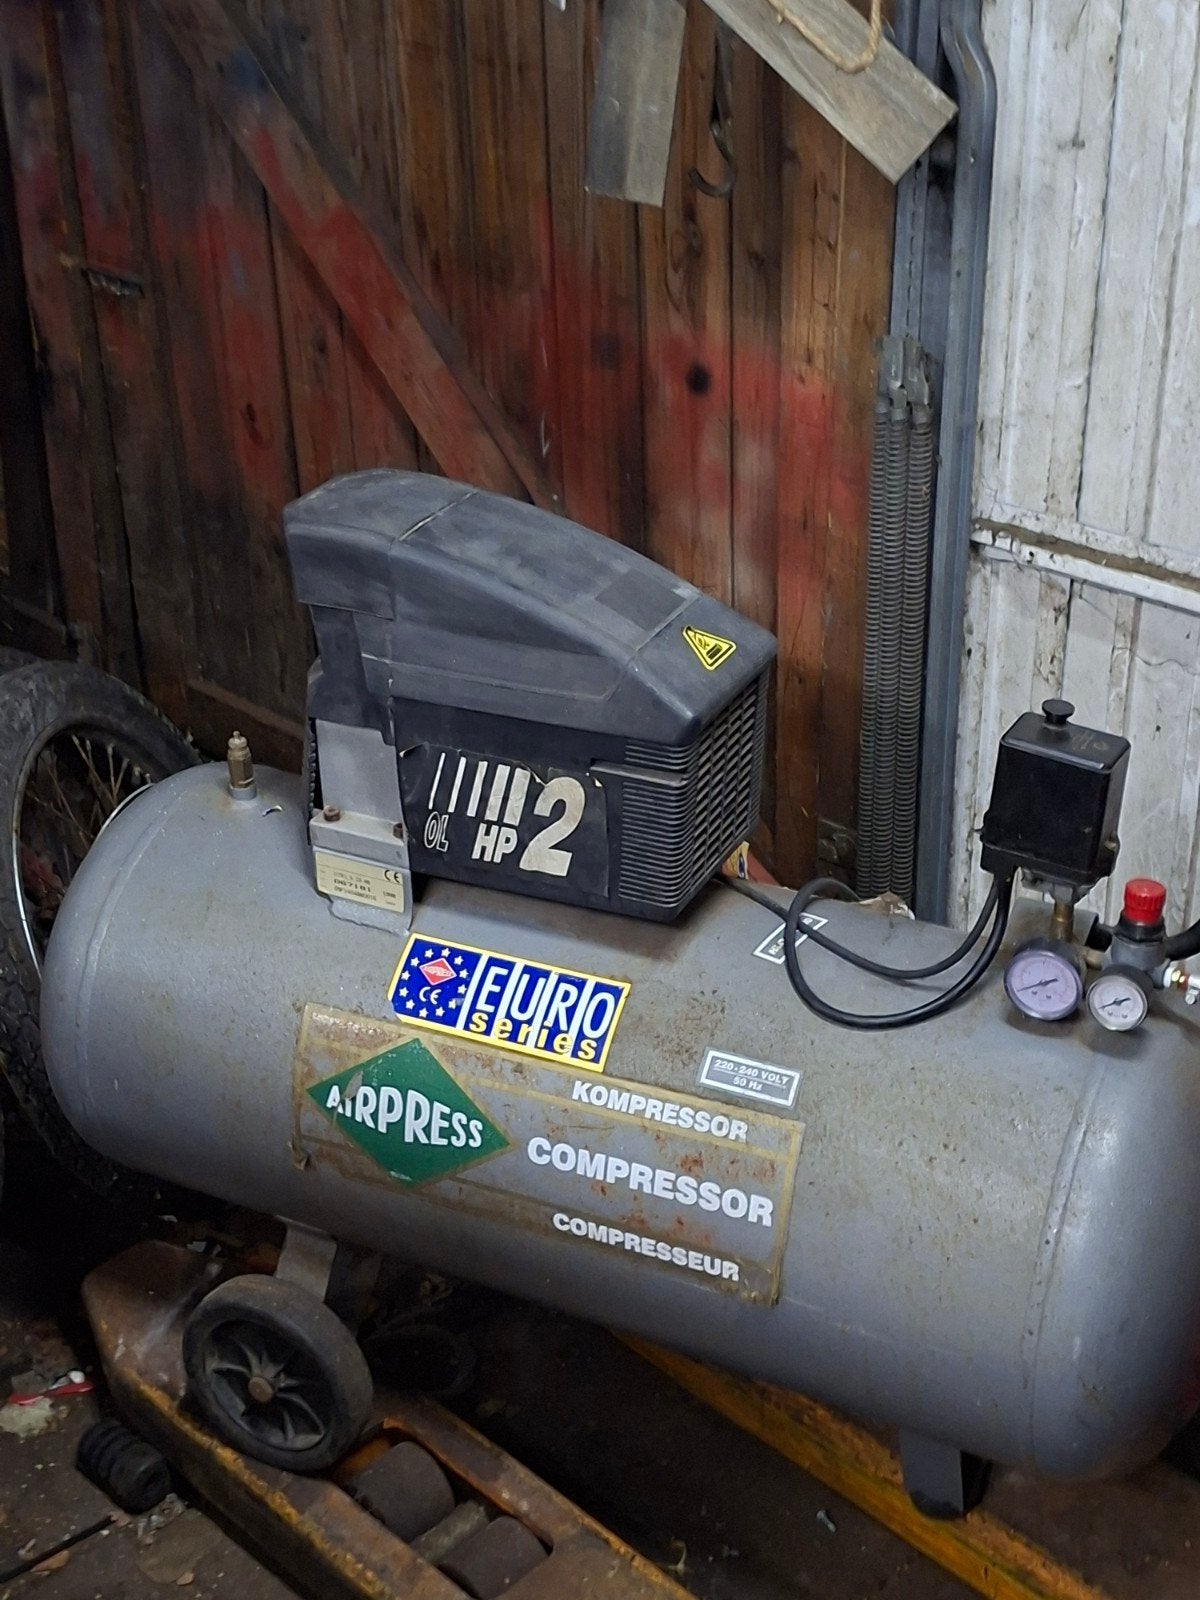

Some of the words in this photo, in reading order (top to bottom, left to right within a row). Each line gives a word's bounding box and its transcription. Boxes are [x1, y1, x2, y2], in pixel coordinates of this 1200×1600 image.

[471, 822, 518, 863] HP
[519, 776, 586, 877] 2
[384, 869, 401, 883] CE
[419, 986, 442, 1005] CE
[475, 965, 615, 1038] EURO
[469, 1012, 598, 1061] series
[733, 1076, 746, 1087] 50
[748, 1080, 763, 1091] Hz
[761, 1071, 790, 1085] VOLT
[326, 1085, 484, 1148] AIRPRESS
[571, 1080, 749, 1143] KOMPRESSOR
[527, 1136, 775, 1227] COMPRESSOR
[552, 1212, 740, 1282] COMPRESSEUR
